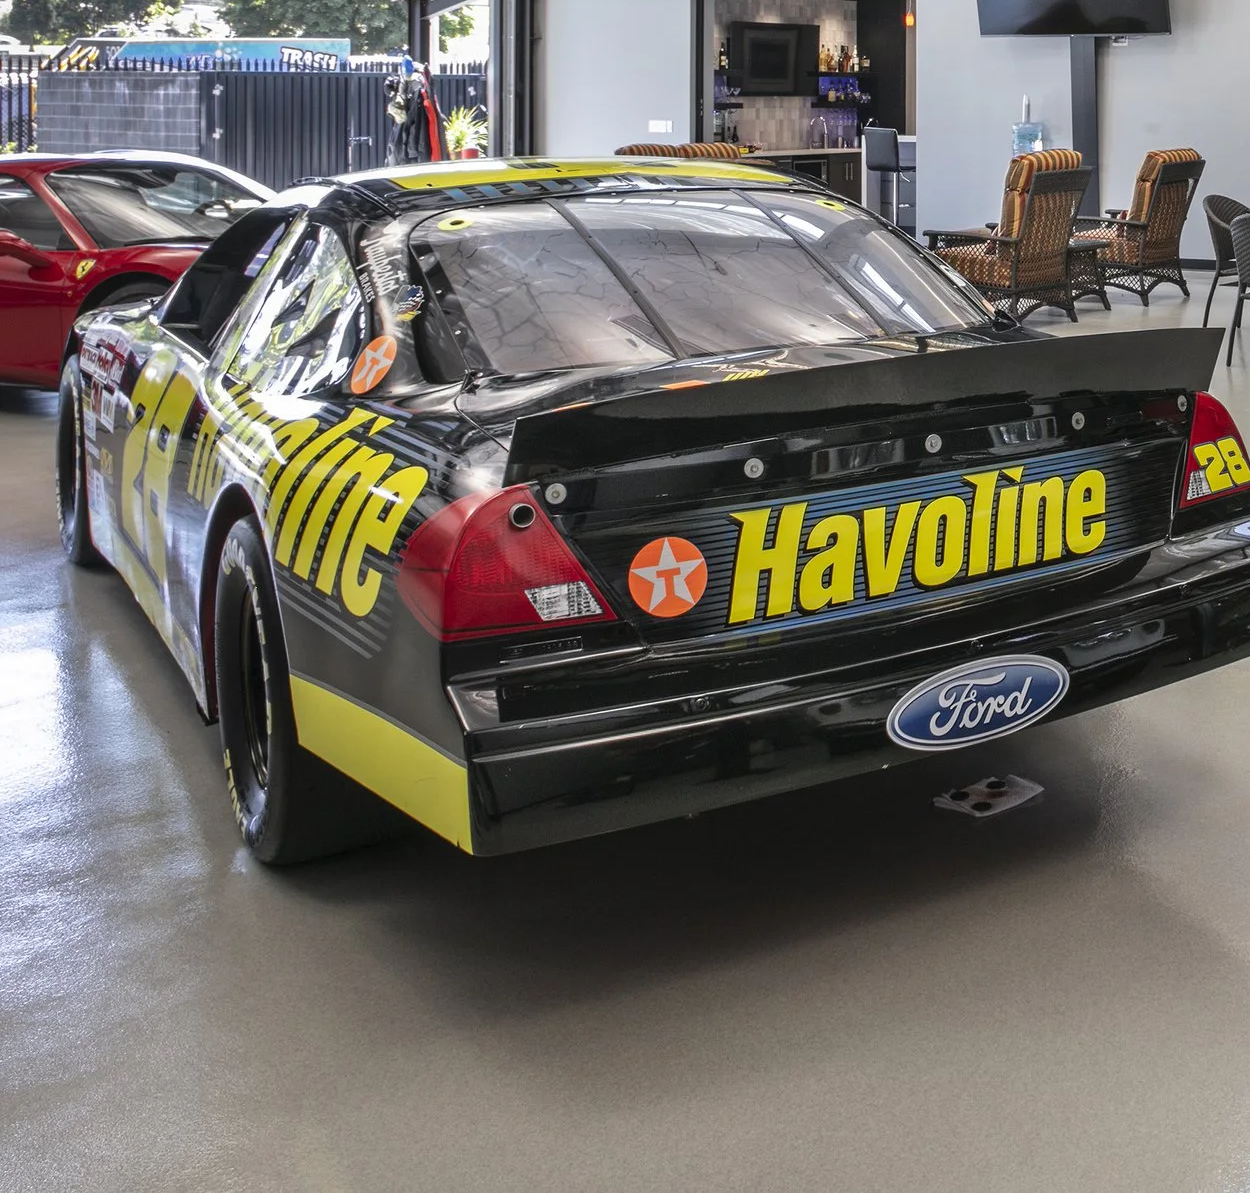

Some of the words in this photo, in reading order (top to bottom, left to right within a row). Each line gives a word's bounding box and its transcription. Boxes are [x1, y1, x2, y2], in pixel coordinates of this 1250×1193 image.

[281, 46, 338, 71] TRASH
[358, 272, 376, 303] BRAKES
[122, 349, 198, 584] 28
[727, 465, 1106, 624] Havoline
[929, 671, 1033, 737] Ford
